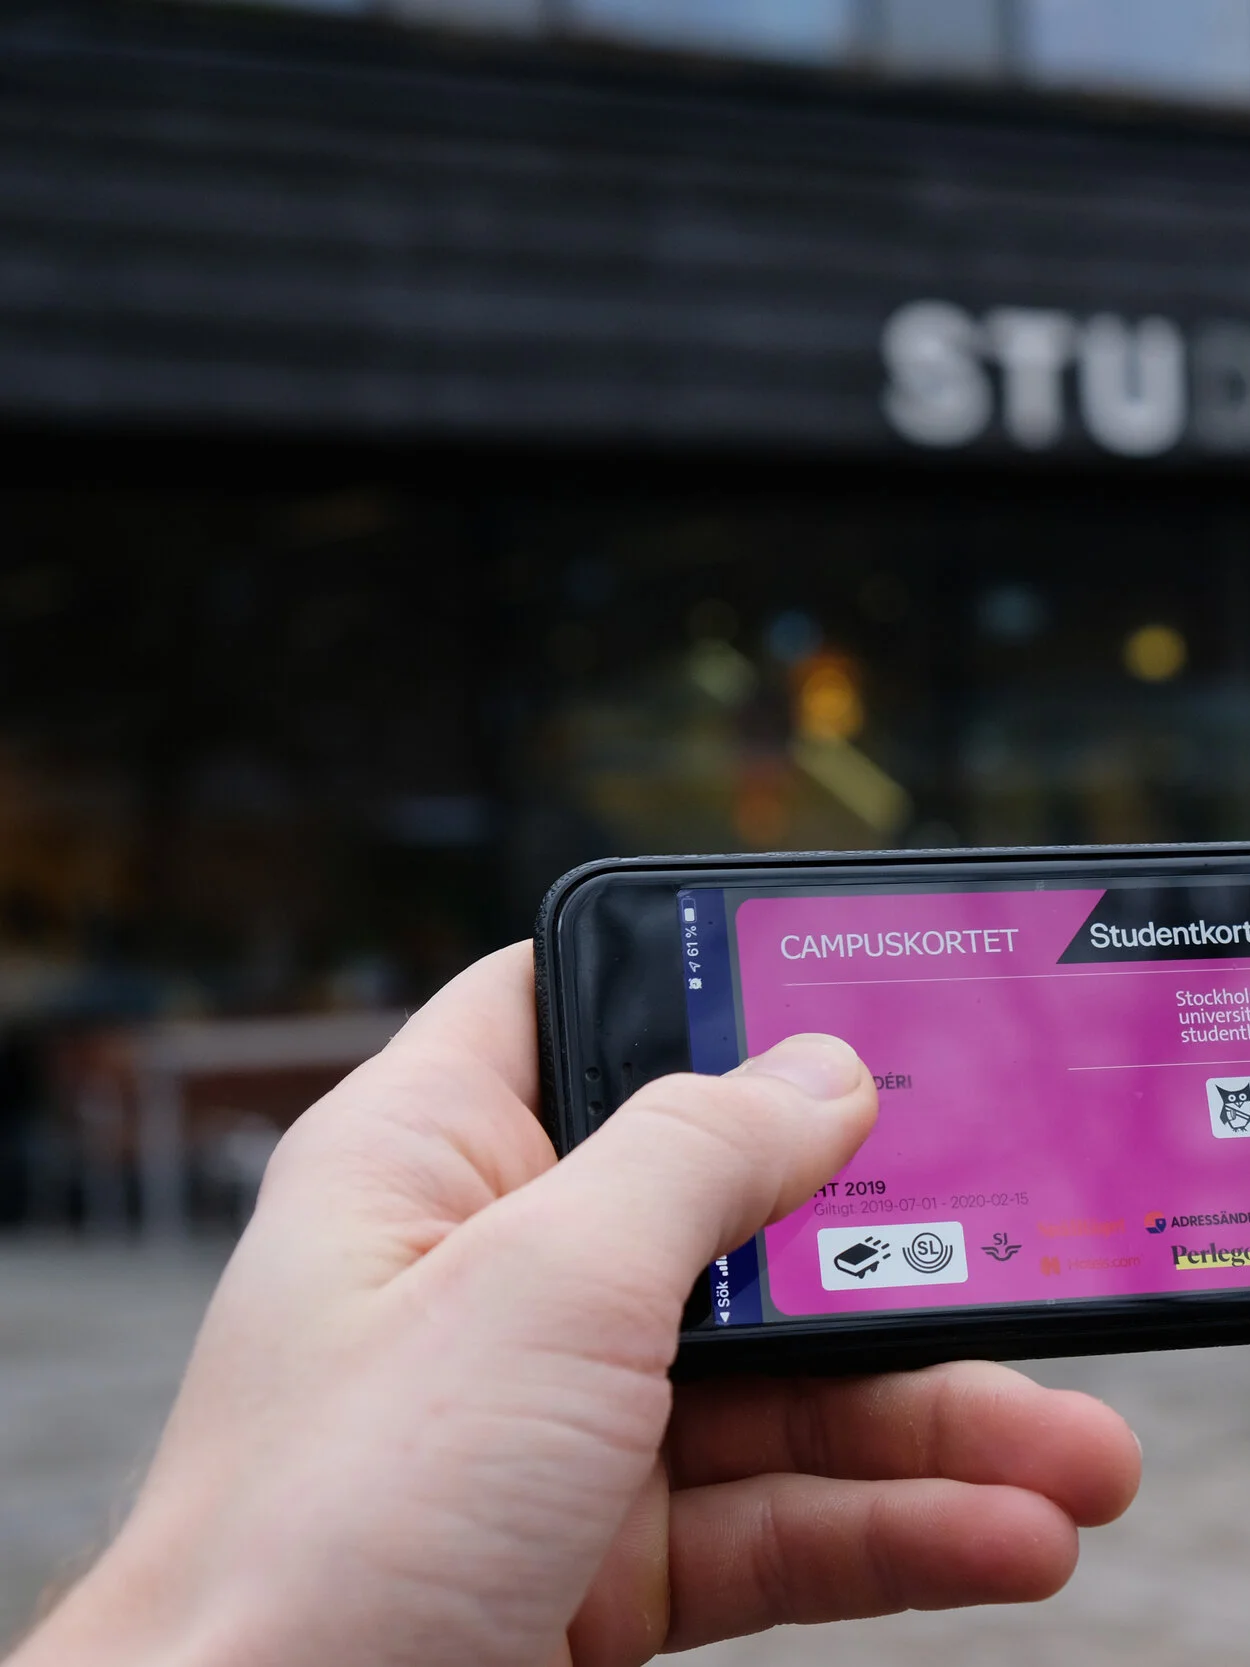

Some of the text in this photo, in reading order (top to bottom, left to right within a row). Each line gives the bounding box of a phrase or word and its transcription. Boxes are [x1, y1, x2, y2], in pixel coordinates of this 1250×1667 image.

[780, 928, 1019, 960] CAMPUSKORTET
[844, 1180, 886, 1196] 2019
[860, 1197, 938, 1214] 2019-07-01
[950, 1192, 1030, 1209] 2020-02-15
[917, 1240, 940, 1256] SL
[716, 1280, 730, 1308] Sök
